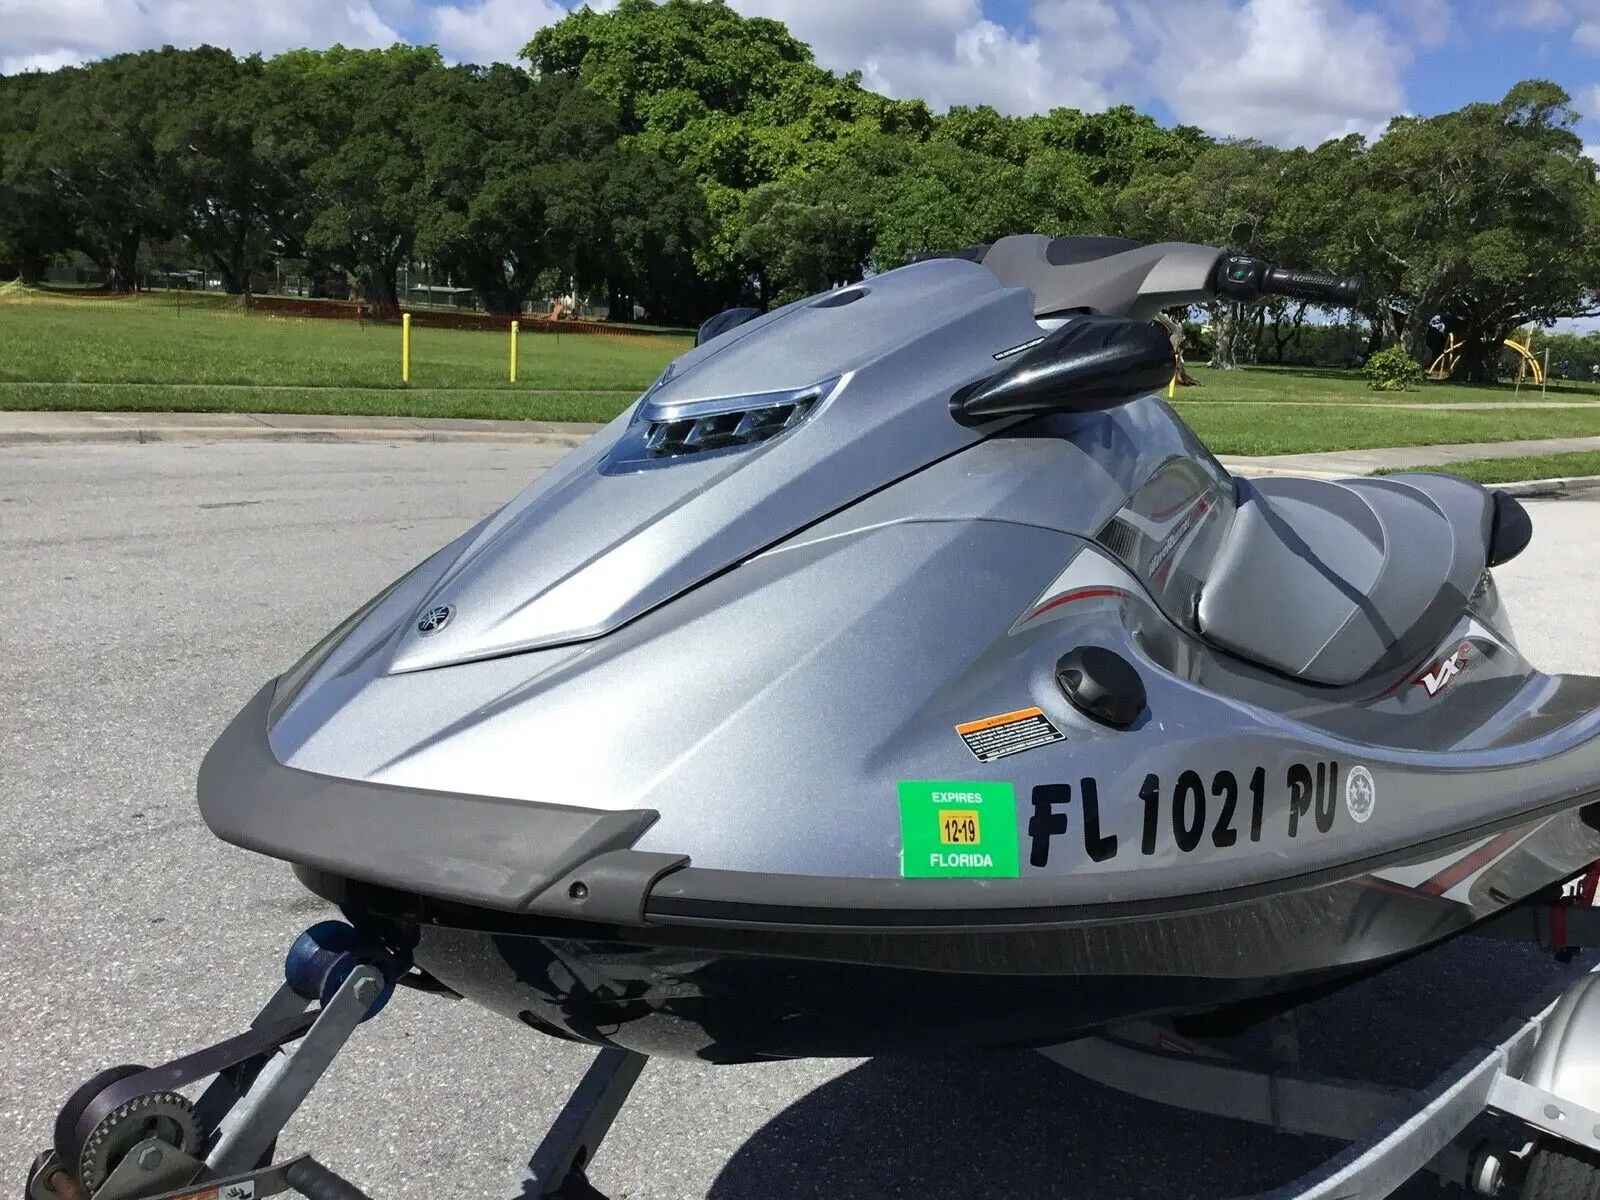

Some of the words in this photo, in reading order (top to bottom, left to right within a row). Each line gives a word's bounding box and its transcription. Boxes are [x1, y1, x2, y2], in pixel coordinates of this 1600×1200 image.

[931, 791, 983, 804] EXPIRES
[1028, 776, 1118, 868] FL
[1138, 766, 1266, 856] 1021
[1287, 761, 1338, 838] PU
[929, 853, 994, 868] FLORIDA
